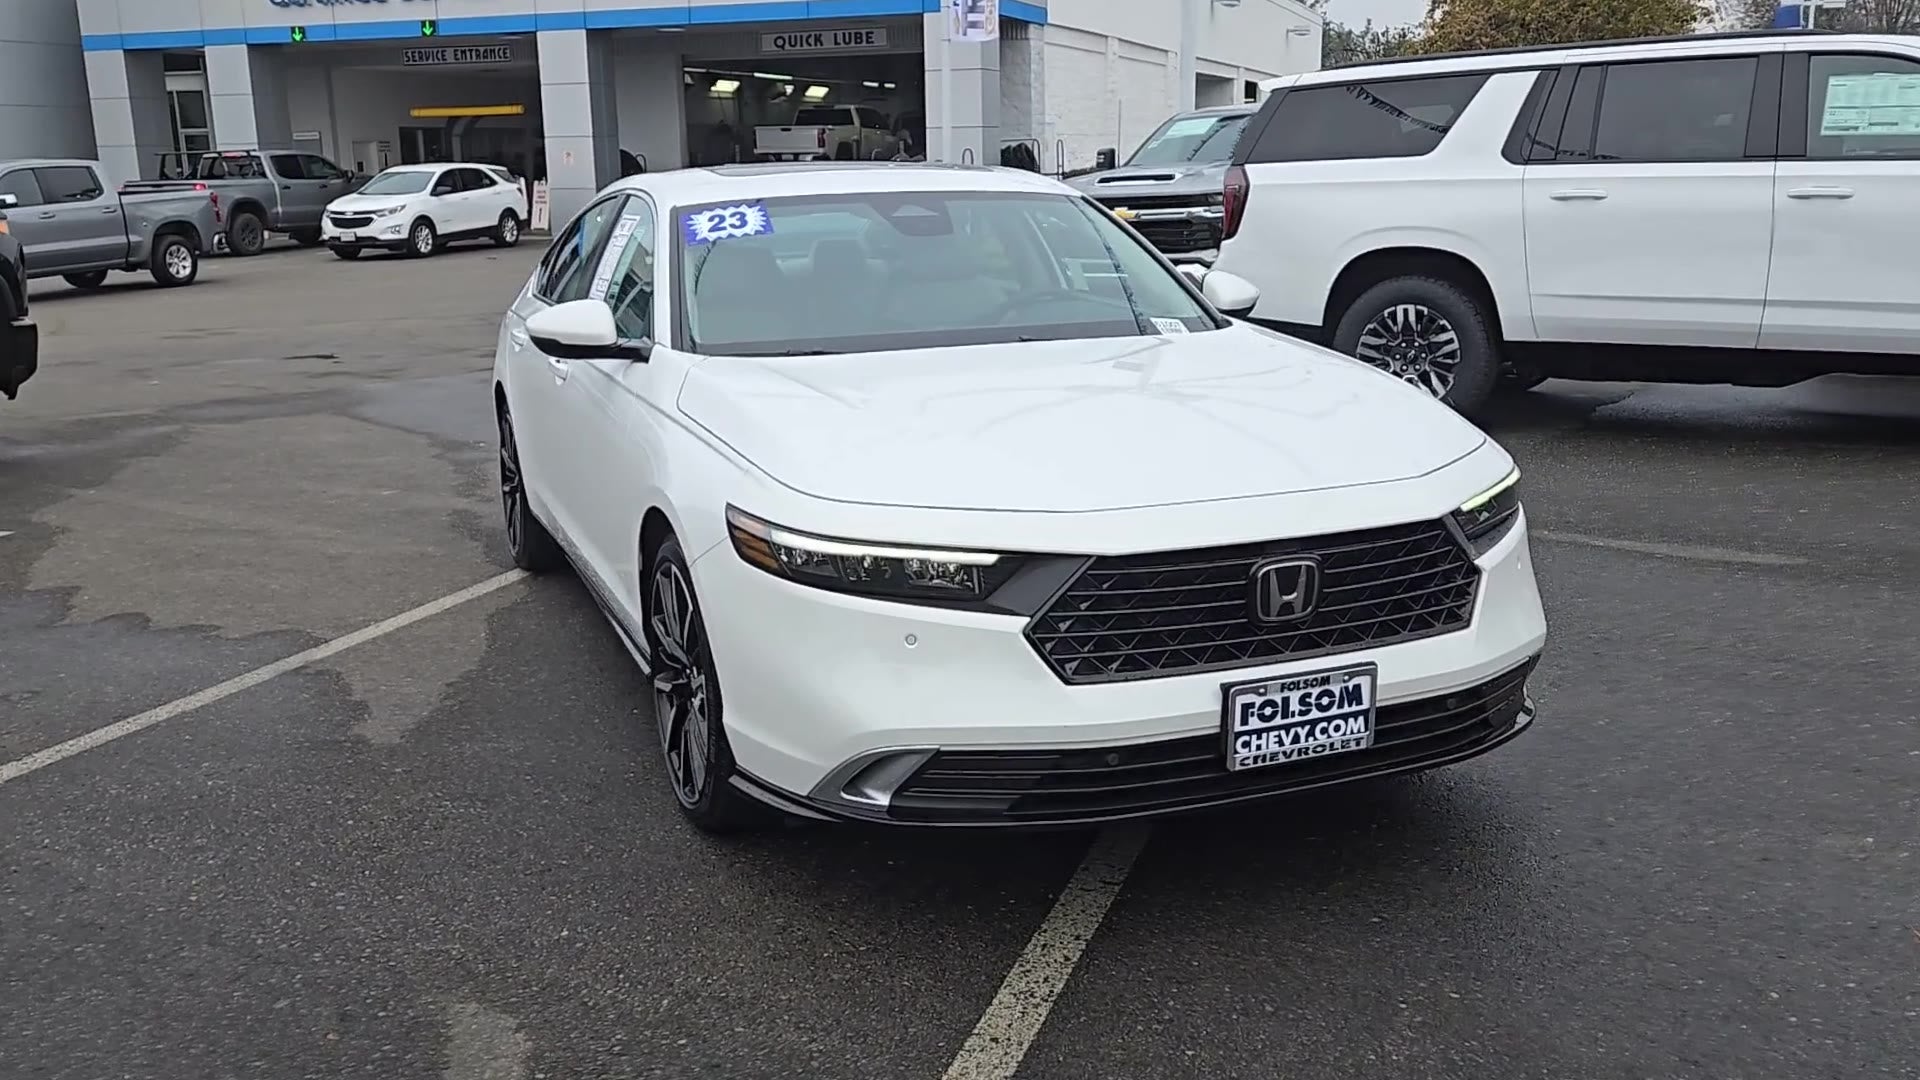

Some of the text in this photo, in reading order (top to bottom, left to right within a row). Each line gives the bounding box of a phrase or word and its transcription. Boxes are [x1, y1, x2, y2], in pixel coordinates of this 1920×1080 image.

[773, 31, 875, 51] QUICK LUBE
[404, 47, 510, 63] SERVICE ENTRANCE
[707, 211, 748, 233] 23
[1280, 675, 1331, 694] FOLSOM
[1239, 683, 1364, 727] FOLSOM
[1235, 715, 1366, 754] CHEVY.COM
[1238, 736, 1365, 767] CHEVROLET
